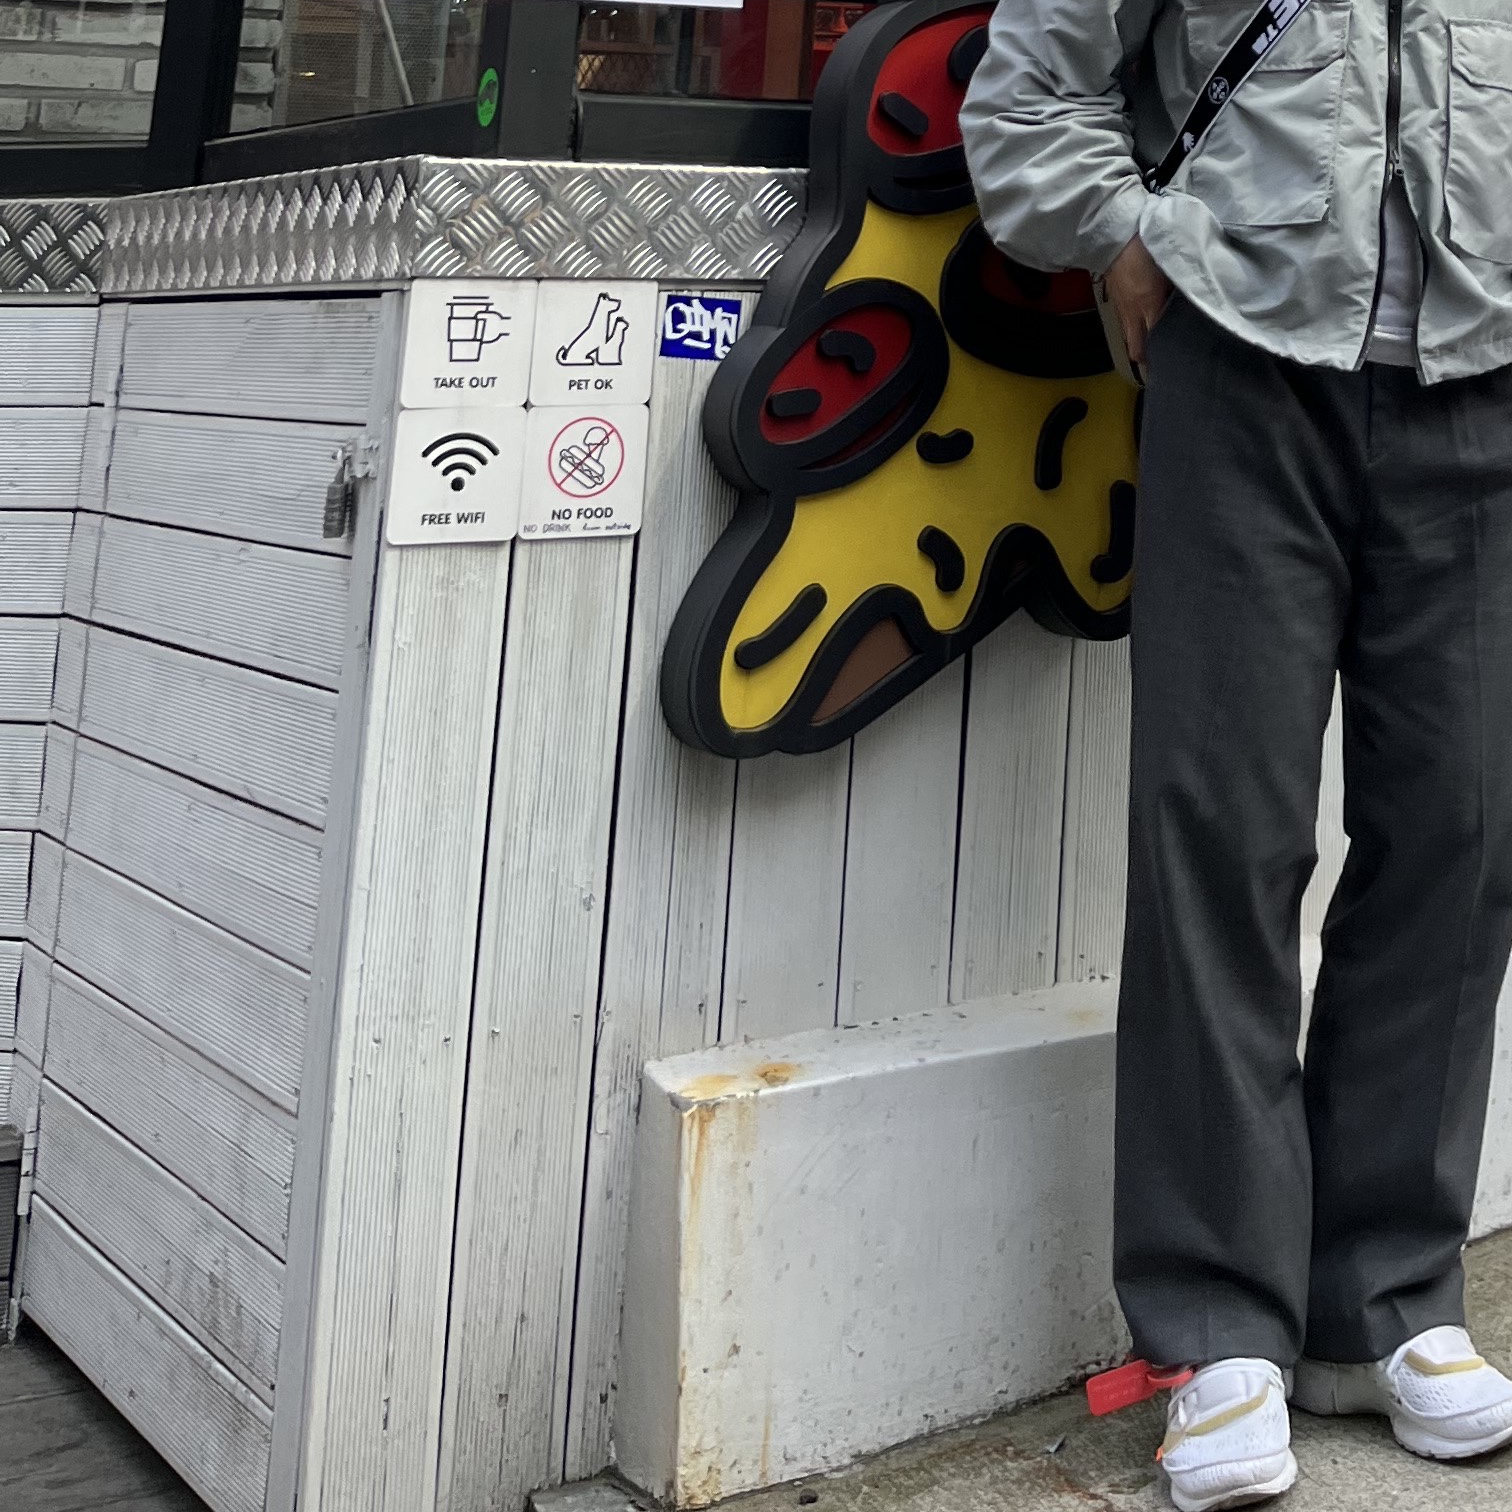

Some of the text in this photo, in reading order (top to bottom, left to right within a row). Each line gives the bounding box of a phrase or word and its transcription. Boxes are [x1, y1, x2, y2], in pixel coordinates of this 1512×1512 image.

[434, 376, 498, 389] TAKE OUT
[568, 378, 613, 391] PET OK
[421, 513, 452, 526] FREE
[551, 507, 614, 520] NO FOOD
[523, 524, 538, 534] NO
